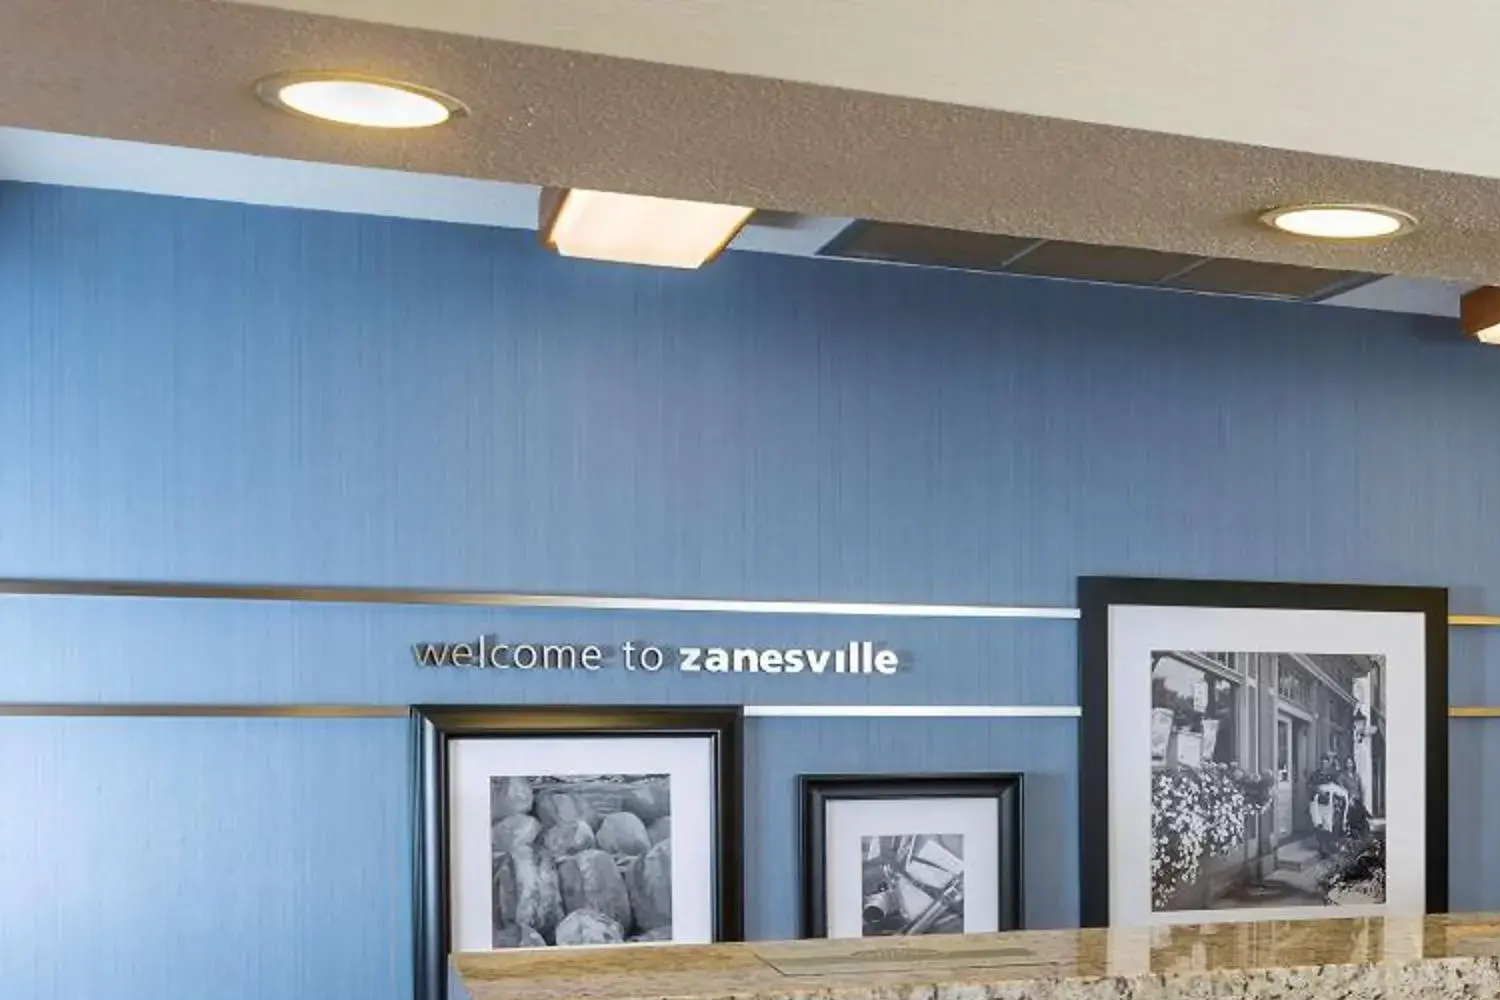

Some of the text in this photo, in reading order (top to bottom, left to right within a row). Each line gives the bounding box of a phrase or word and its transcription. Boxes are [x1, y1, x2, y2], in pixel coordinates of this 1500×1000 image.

[413, 634, 899, 675] welcome to zanesville
